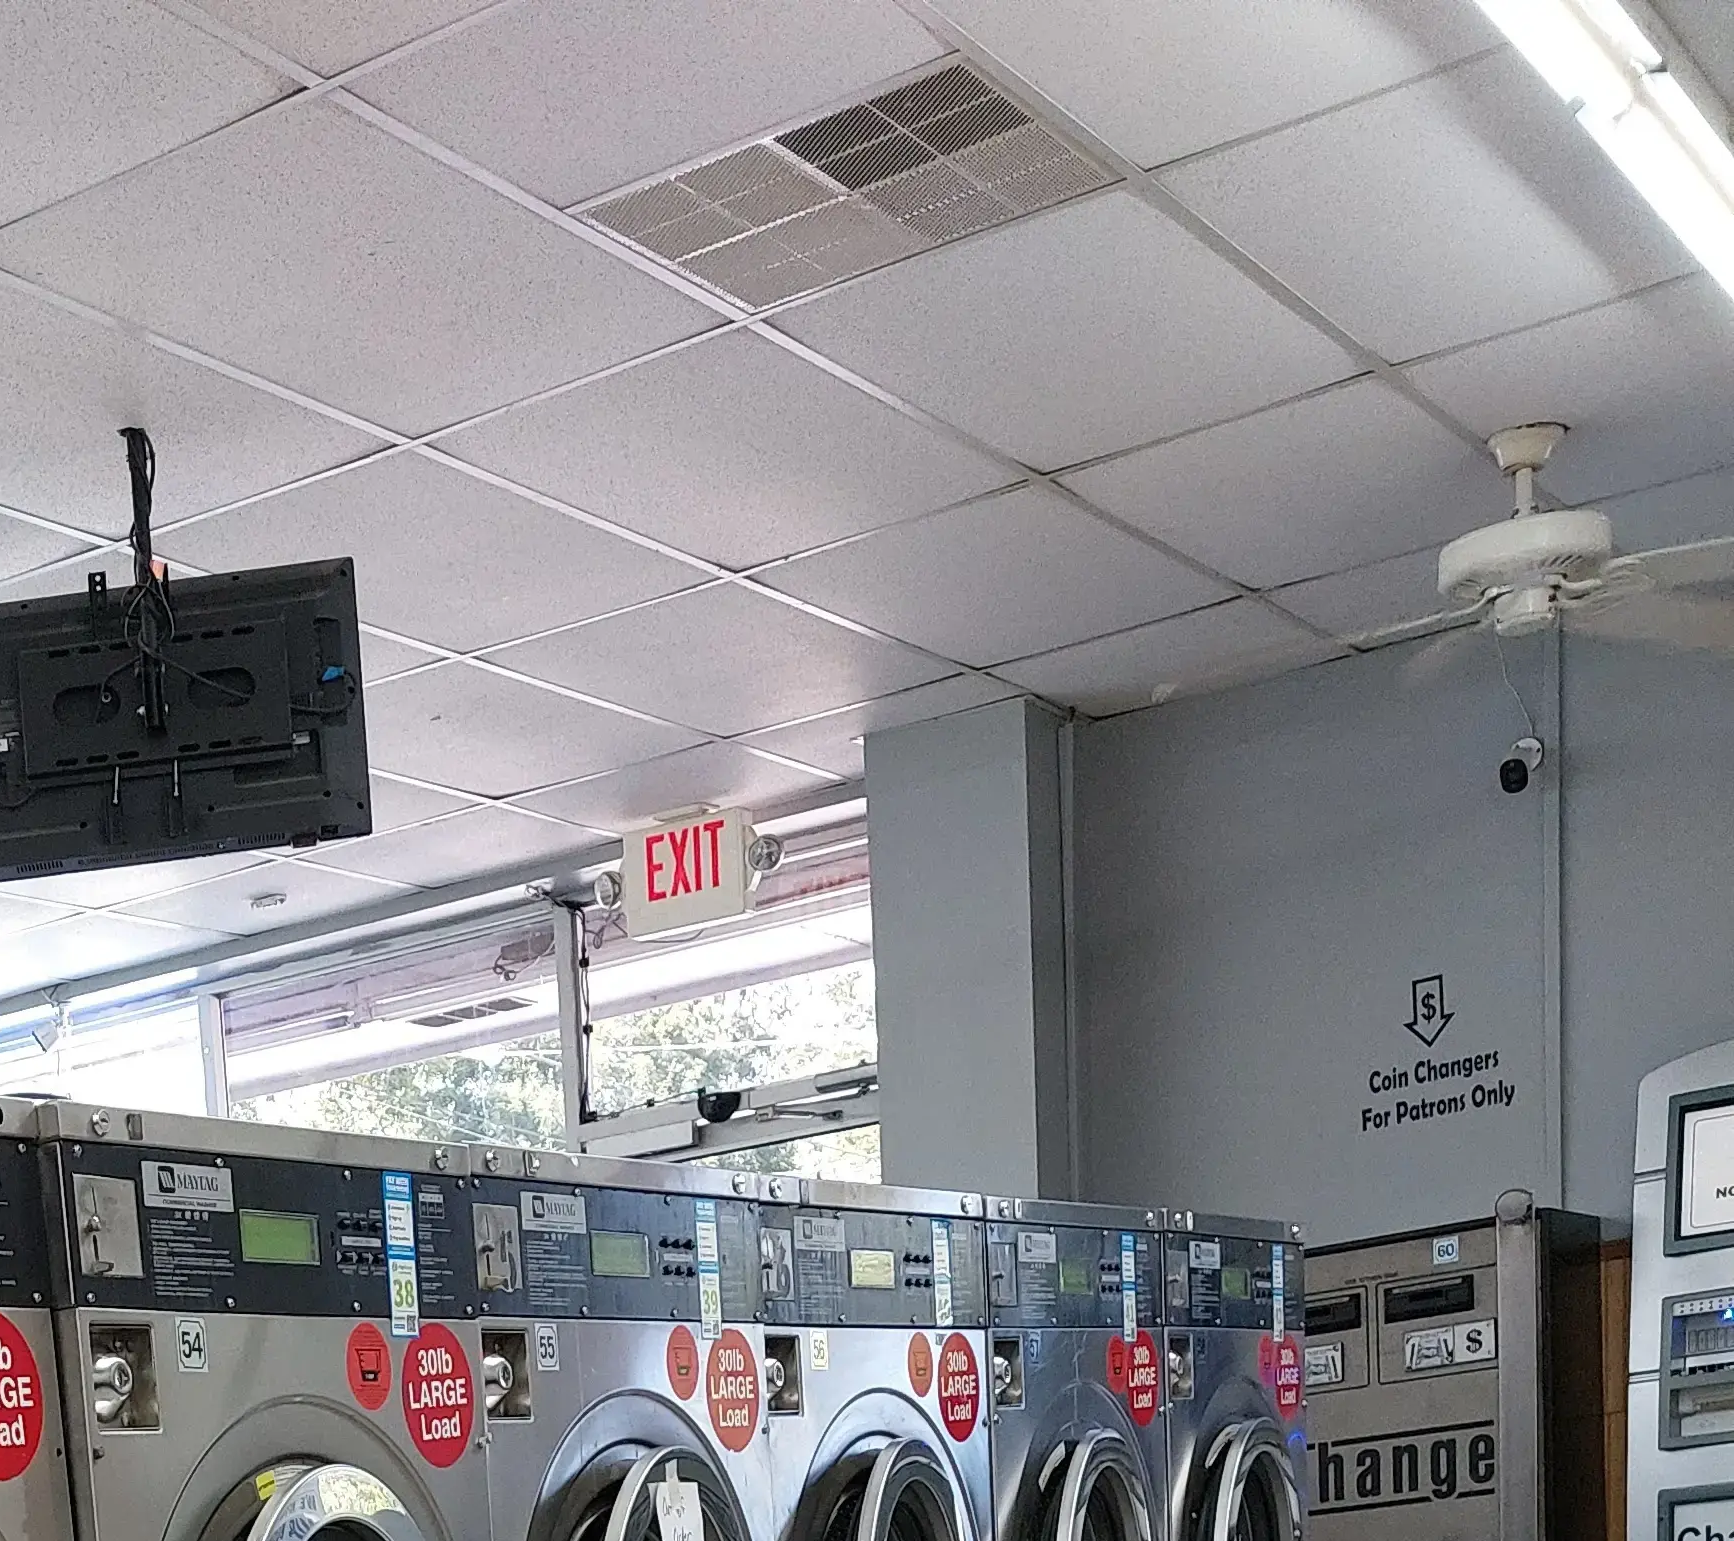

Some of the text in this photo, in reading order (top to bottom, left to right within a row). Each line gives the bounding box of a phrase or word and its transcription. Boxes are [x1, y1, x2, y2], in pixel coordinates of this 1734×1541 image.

[646, 820, 725, 902] EXIT
[1369, 1050, 1499, 1093] Coin Changers
[1361, 1080, 1515, 1131] For Patrons Only
[176, 1173, 218, 1191] MAYTAG
[1437, 1243, 1455, 1257] 60
[393, 1279, 415, 1308] 38
[703, 1290, 718, 1314] 39
[180, 1331, 203, 1359] 54
[539, 1336, 555, 1359] 55
[1466, 1328, 1483, 1354] $
[418, 1347, 453, 1376] 30lb
[718, 1348, 745, 1373] 30lb
[946, 1351, 968, 1373] 30lb
[1133, 1345, 1151, 1365] 30lb
[710, 1376, 755, 1400] LARGE
[941, 1375, 977, 1398] LARGE
[1128, 1368, 1157, 1388] LARGE
[1276, 1367, 1300, 1385] LARGE
[409, 1378, 468, 1410] LARGE
[1133, 1390, 1153, 1409] Load
[1280, 1388, 1297, 1405] Load
[718, 1404, 749, 1428] Load
[947, 1400, 972, 1422] Load
[421, 1411, 461, 1441] Load
[1318, 1434, 1495, 1503] hange
